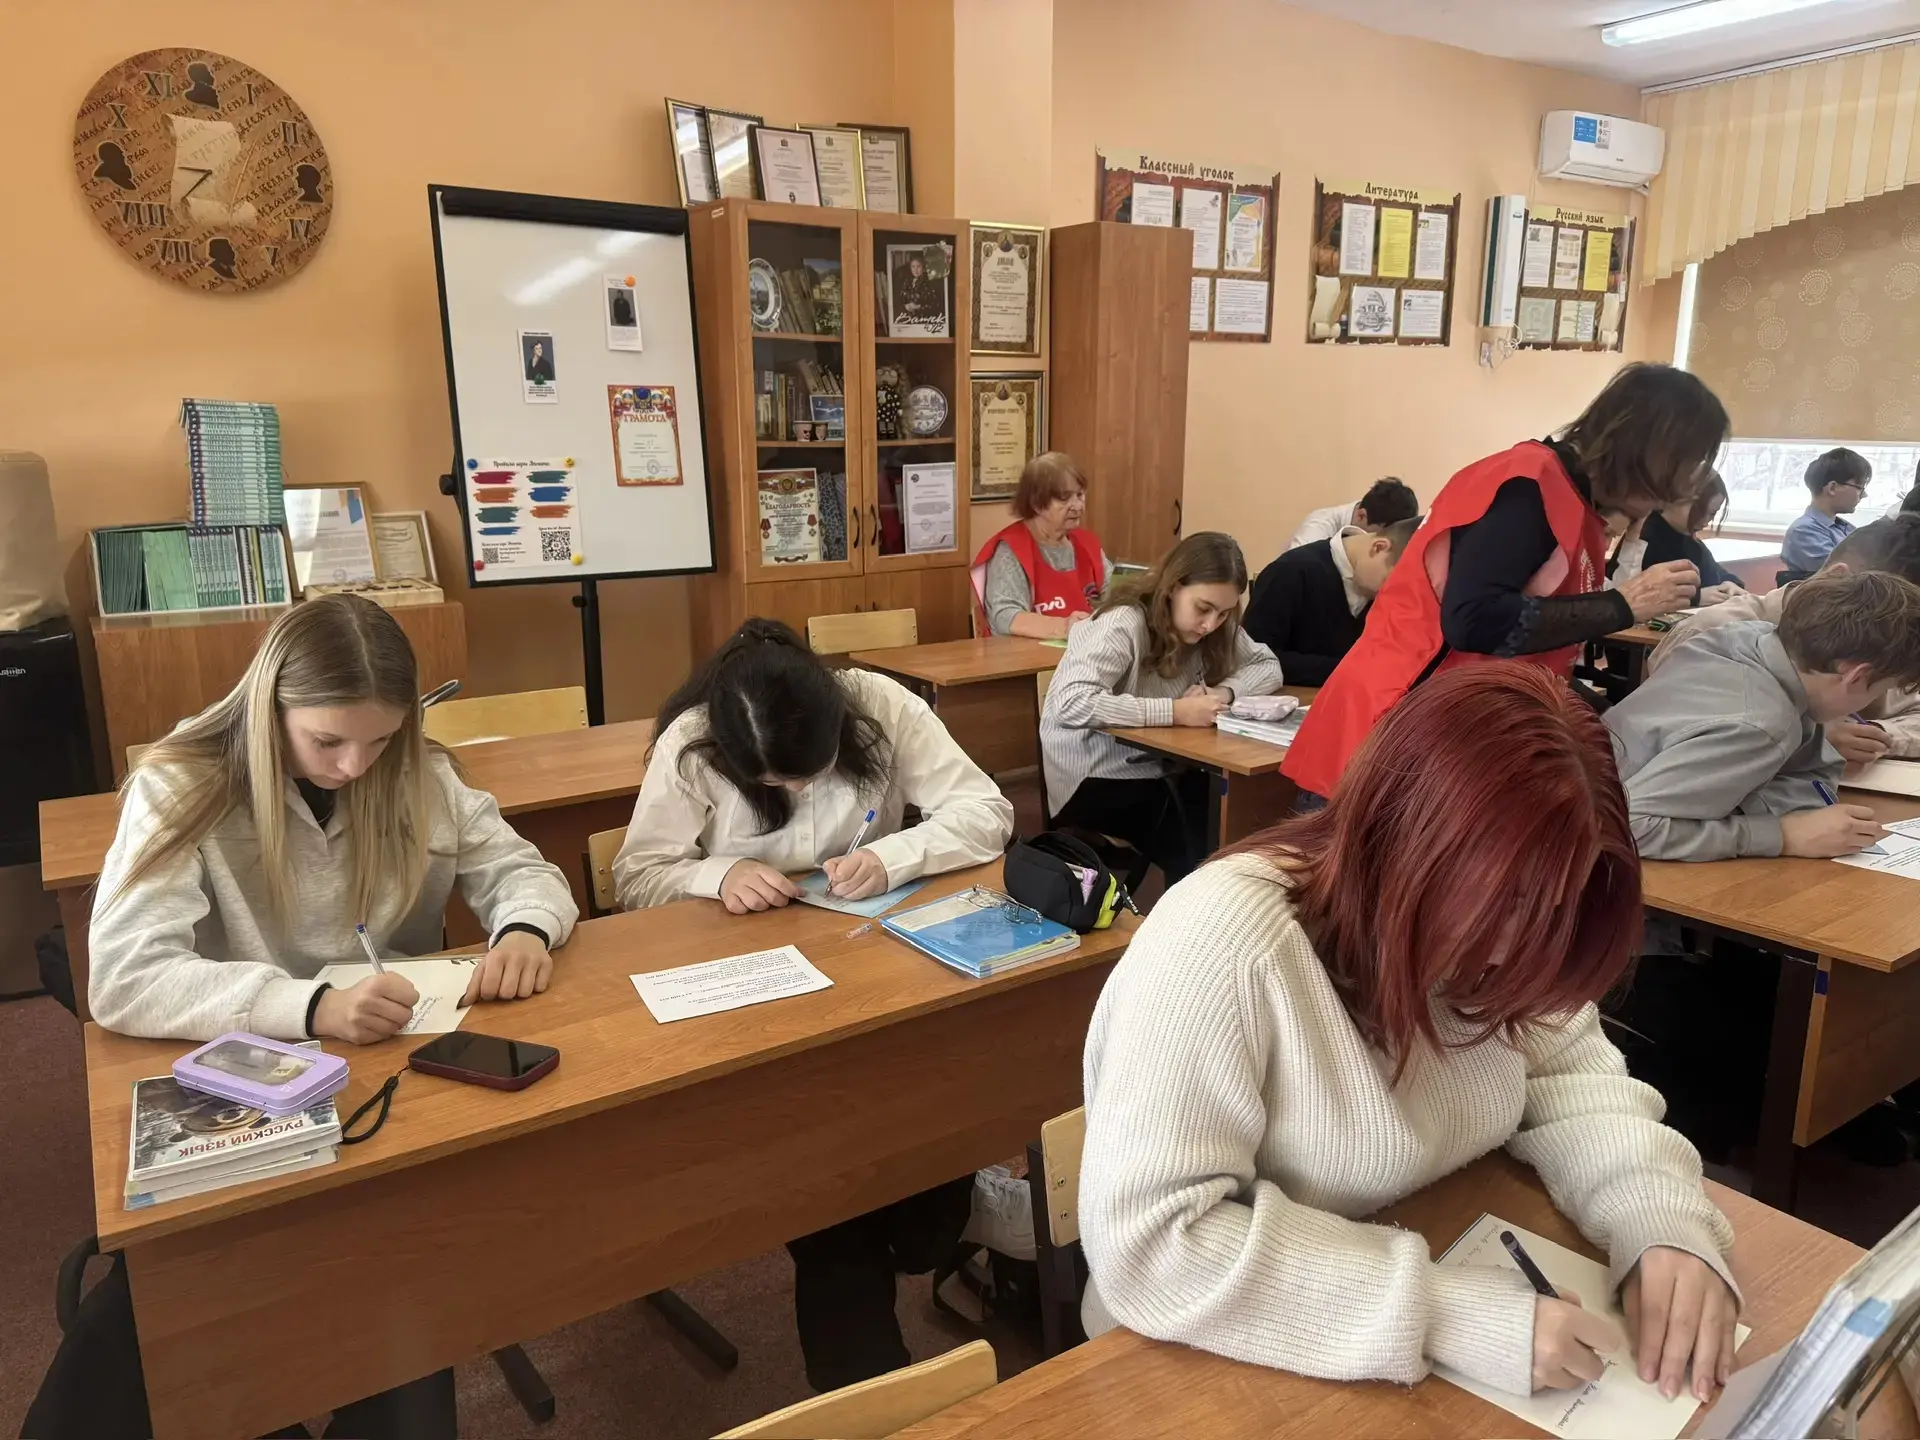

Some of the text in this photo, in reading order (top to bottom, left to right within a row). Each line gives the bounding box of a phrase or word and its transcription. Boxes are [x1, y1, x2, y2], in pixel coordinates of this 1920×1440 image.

[107, 103, 129, 129] X
[1139, 155, 1234, 182] Классный уголок
[1364, 181, 1419, 202] Литература
[1555, 207, 1604, 224] Русский язык
[623, 413, 667, 423] ГРАМОТА
[178, 1119, 304, 1157] РУССКИЙ ЯЗЫК
